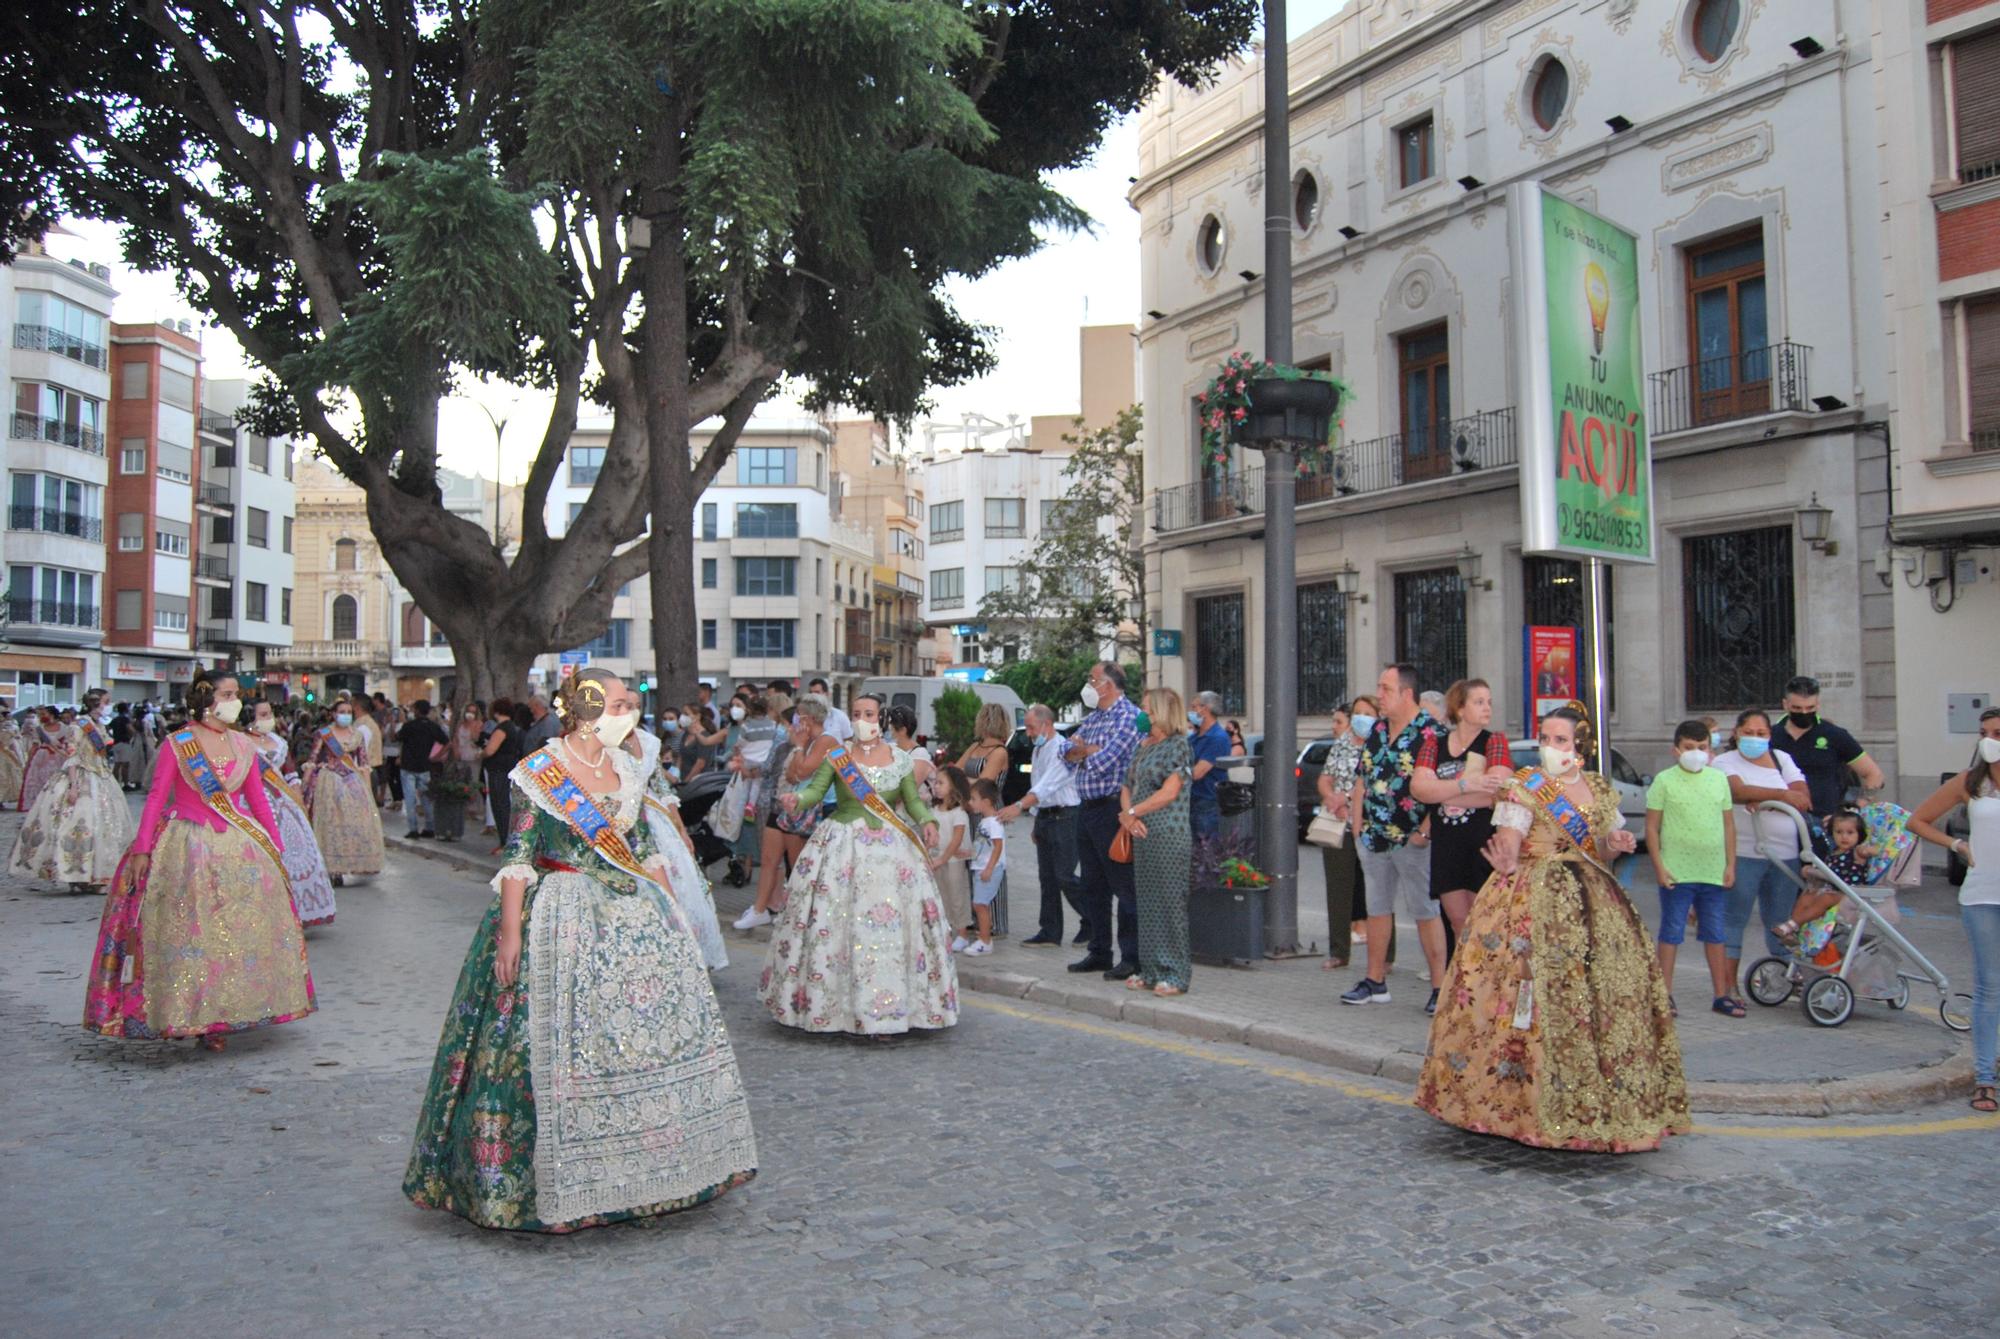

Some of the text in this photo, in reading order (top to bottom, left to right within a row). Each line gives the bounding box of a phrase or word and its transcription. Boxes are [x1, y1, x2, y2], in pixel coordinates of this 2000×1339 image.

[1553, 217, 1561, 235] Y
[1563, 226, 1576, 241] se
[1590, 355, 1607, 384] TU
[1564, 382, 1626, 423] ANUNCIO
[1556, 409, 1639, 499] AQUÍ
